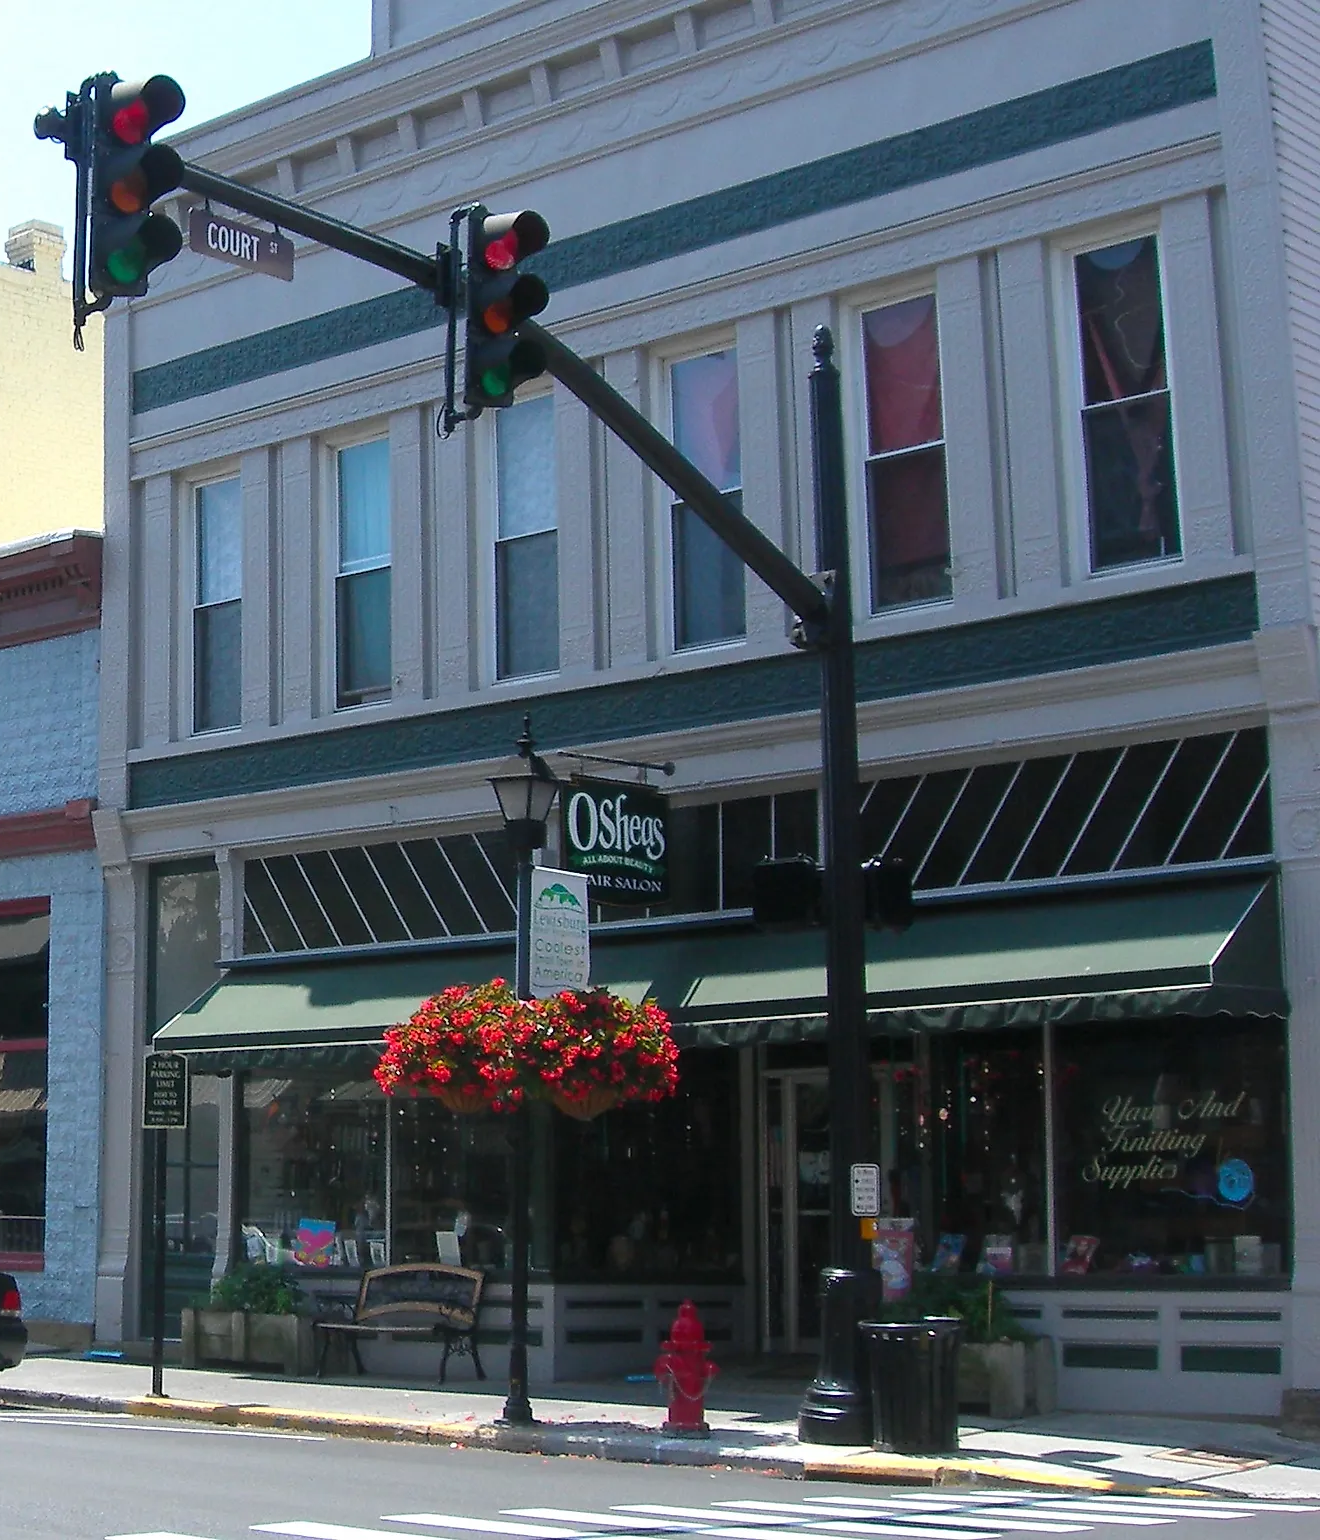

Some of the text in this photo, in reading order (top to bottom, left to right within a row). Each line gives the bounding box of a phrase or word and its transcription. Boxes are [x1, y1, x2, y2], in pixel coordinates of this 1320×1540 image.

[207, 222, 260, 262] COURT
[583, 855, 654, 874] ALL ABOUT BEAUTY
[587, 874, 662, 892] AIR SALON
[535, 938, 586, 956] Coolest
[535, 966, 584, 983] America
[152, 1060, 179, 1069] 2 HOUR
[150, 1070, 181, 1079] PARKING
[156, 1080, 175, 1089] LIMIT
[153, 1099, 177, 1107] CORNER
[1178, 1089, 1247, 1120] And
